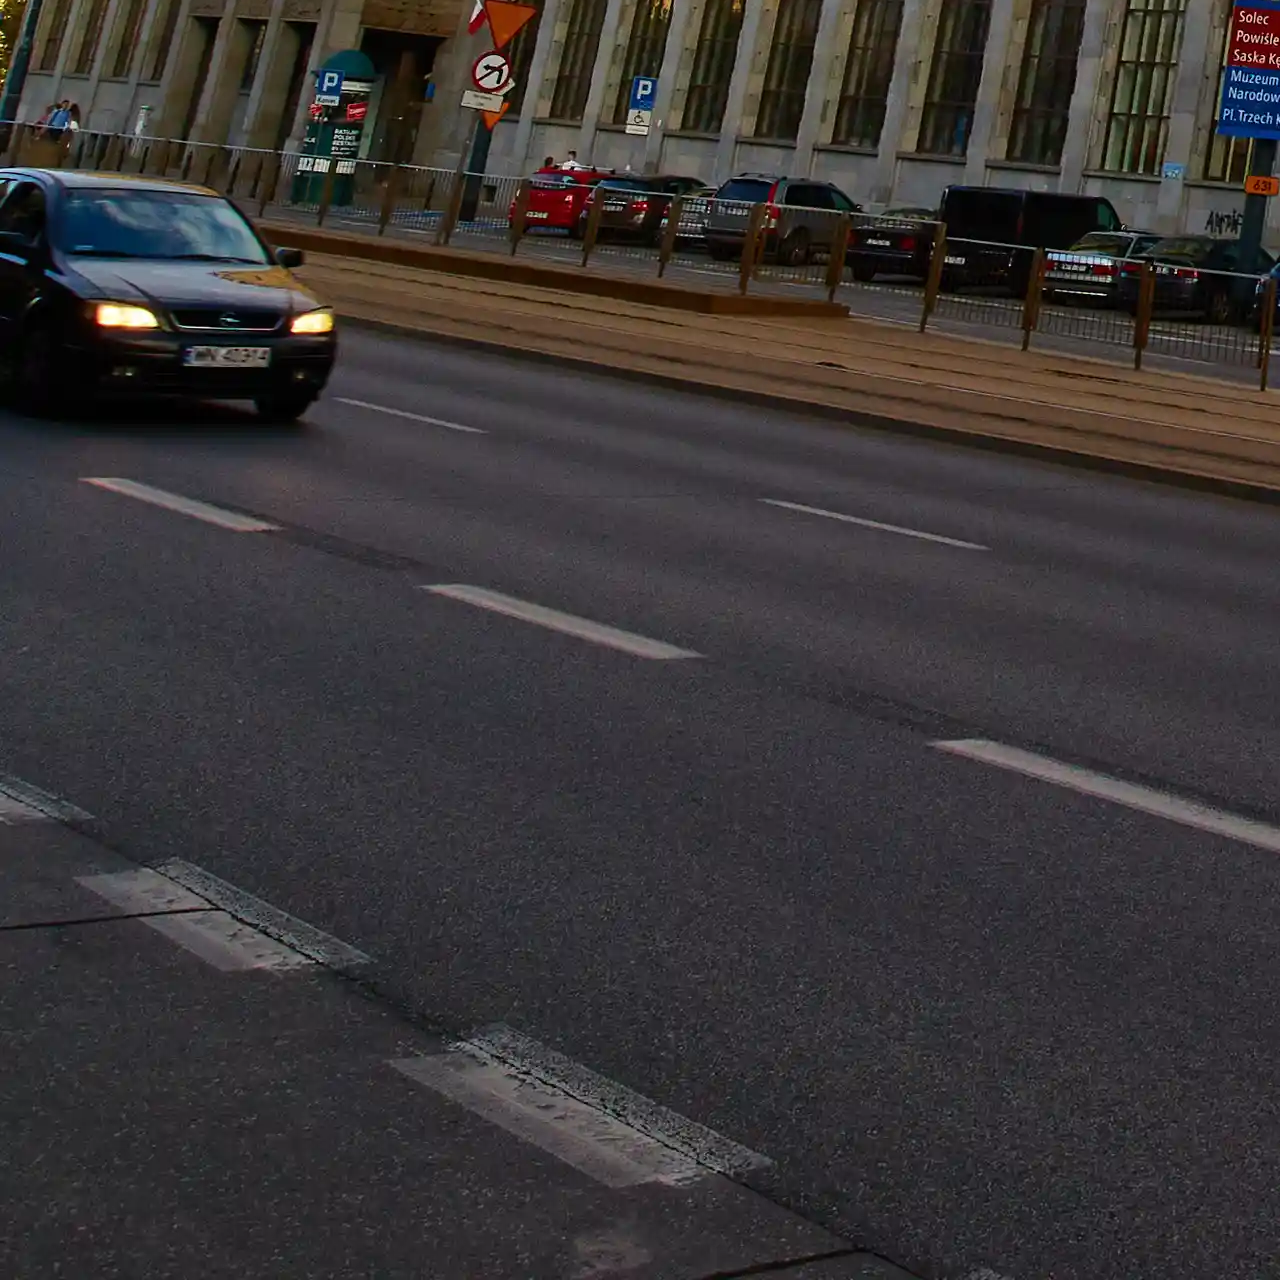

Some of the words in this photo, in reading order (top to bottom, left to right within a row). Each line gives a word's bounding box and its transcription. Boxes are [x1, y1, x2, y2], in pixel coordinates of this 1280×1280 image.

[1238, 10, 1270, 26] Solec
[1235, 29, 1280, 47] Powiśle
[1232, 48, 1266, 65] Saska
[1229, 69, 1280, 87] Muzeum
[1222, 108, 1237, 122] Pl.
[1238, 109, 1273, 125] Trzech
[1253, 180, 1272, 191] 631
